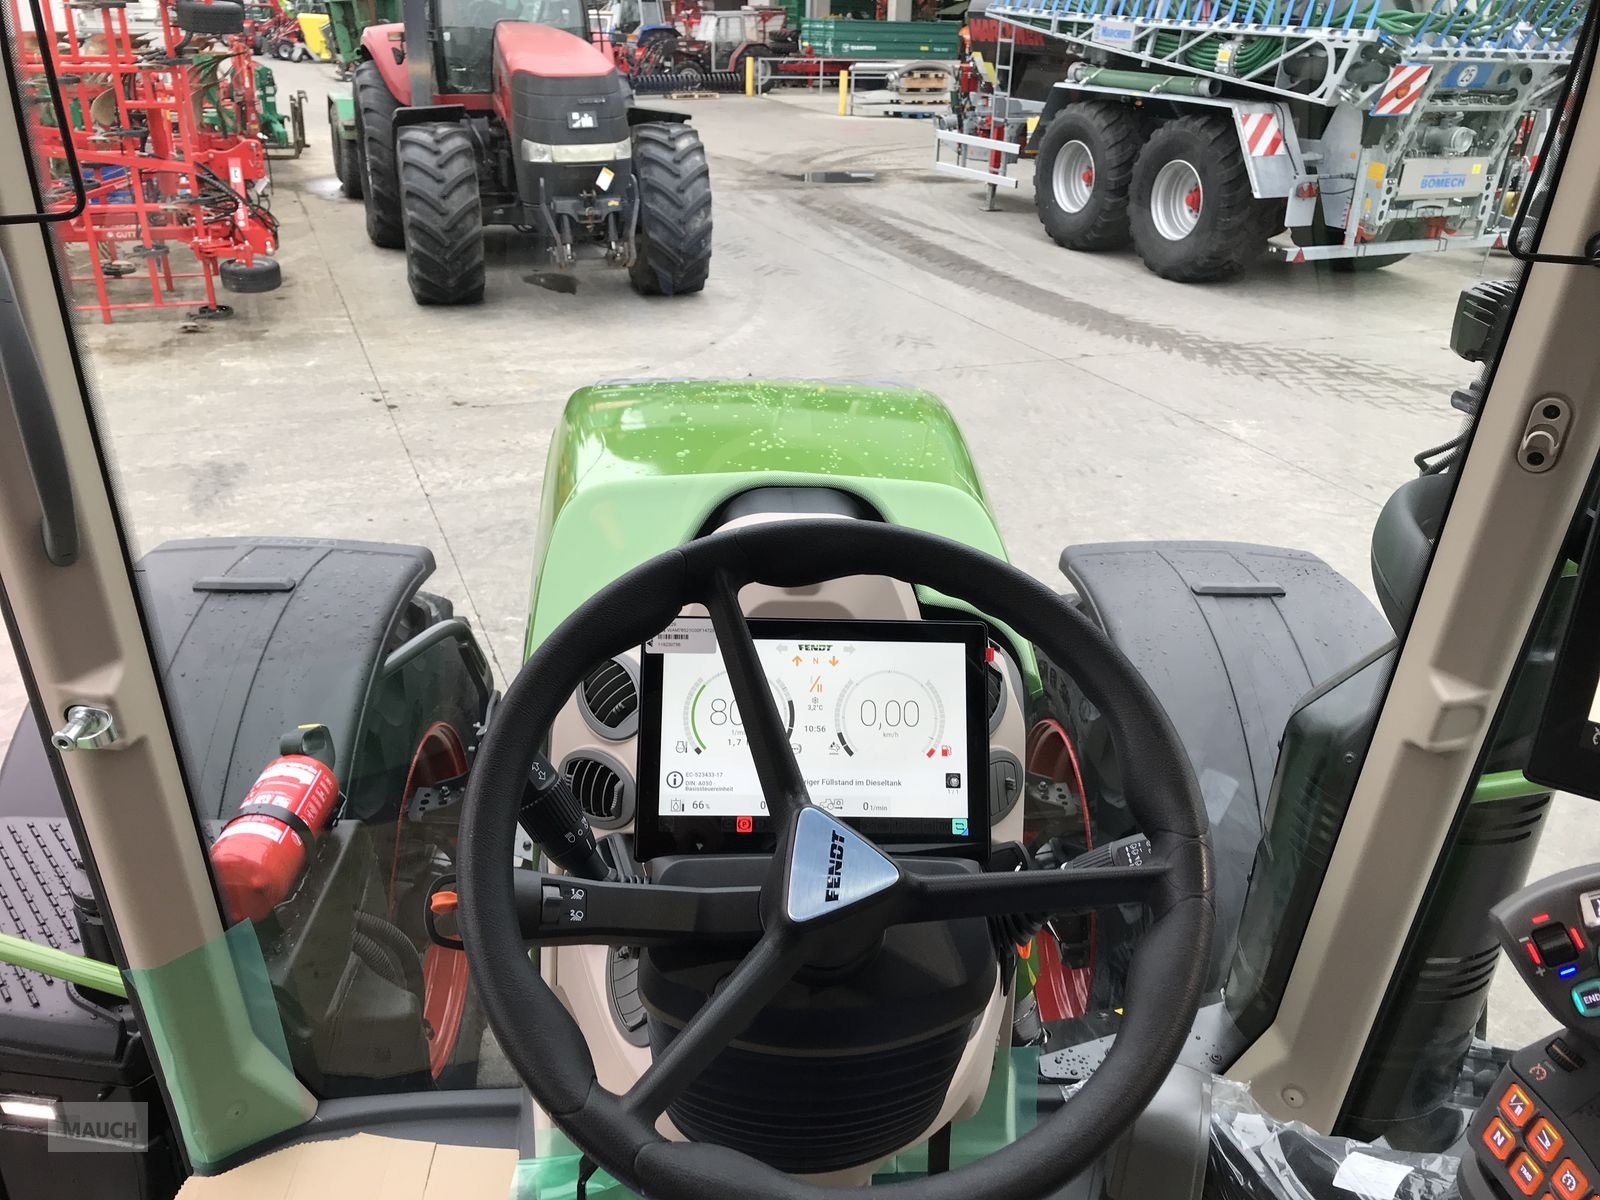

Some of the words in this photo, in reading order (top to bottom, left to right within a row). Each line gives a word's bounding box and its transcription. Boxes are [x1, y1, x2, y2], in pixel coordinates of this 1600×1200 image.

[1460, 68, 1476, 83] 25
[1420, 177, 1467, 189] BOMECH
[798, 644, 834, 652] FENDT
[860, 699, 920, 731] 0,00
[804, 725, 827, 733] 10:56
[822, 776, 854, 787] Füllstand
[855, 778, 865, 786] im
[866, 778, 902, 787] Dieseltank
[692, 801, 705, 810] 66
[862, 801, 869, 811] 0
[825, 829, 845, 902] FENDT
[1492, 1130, 1506, 1147] N
[1520, 1163, 1533, 1183] TMS
